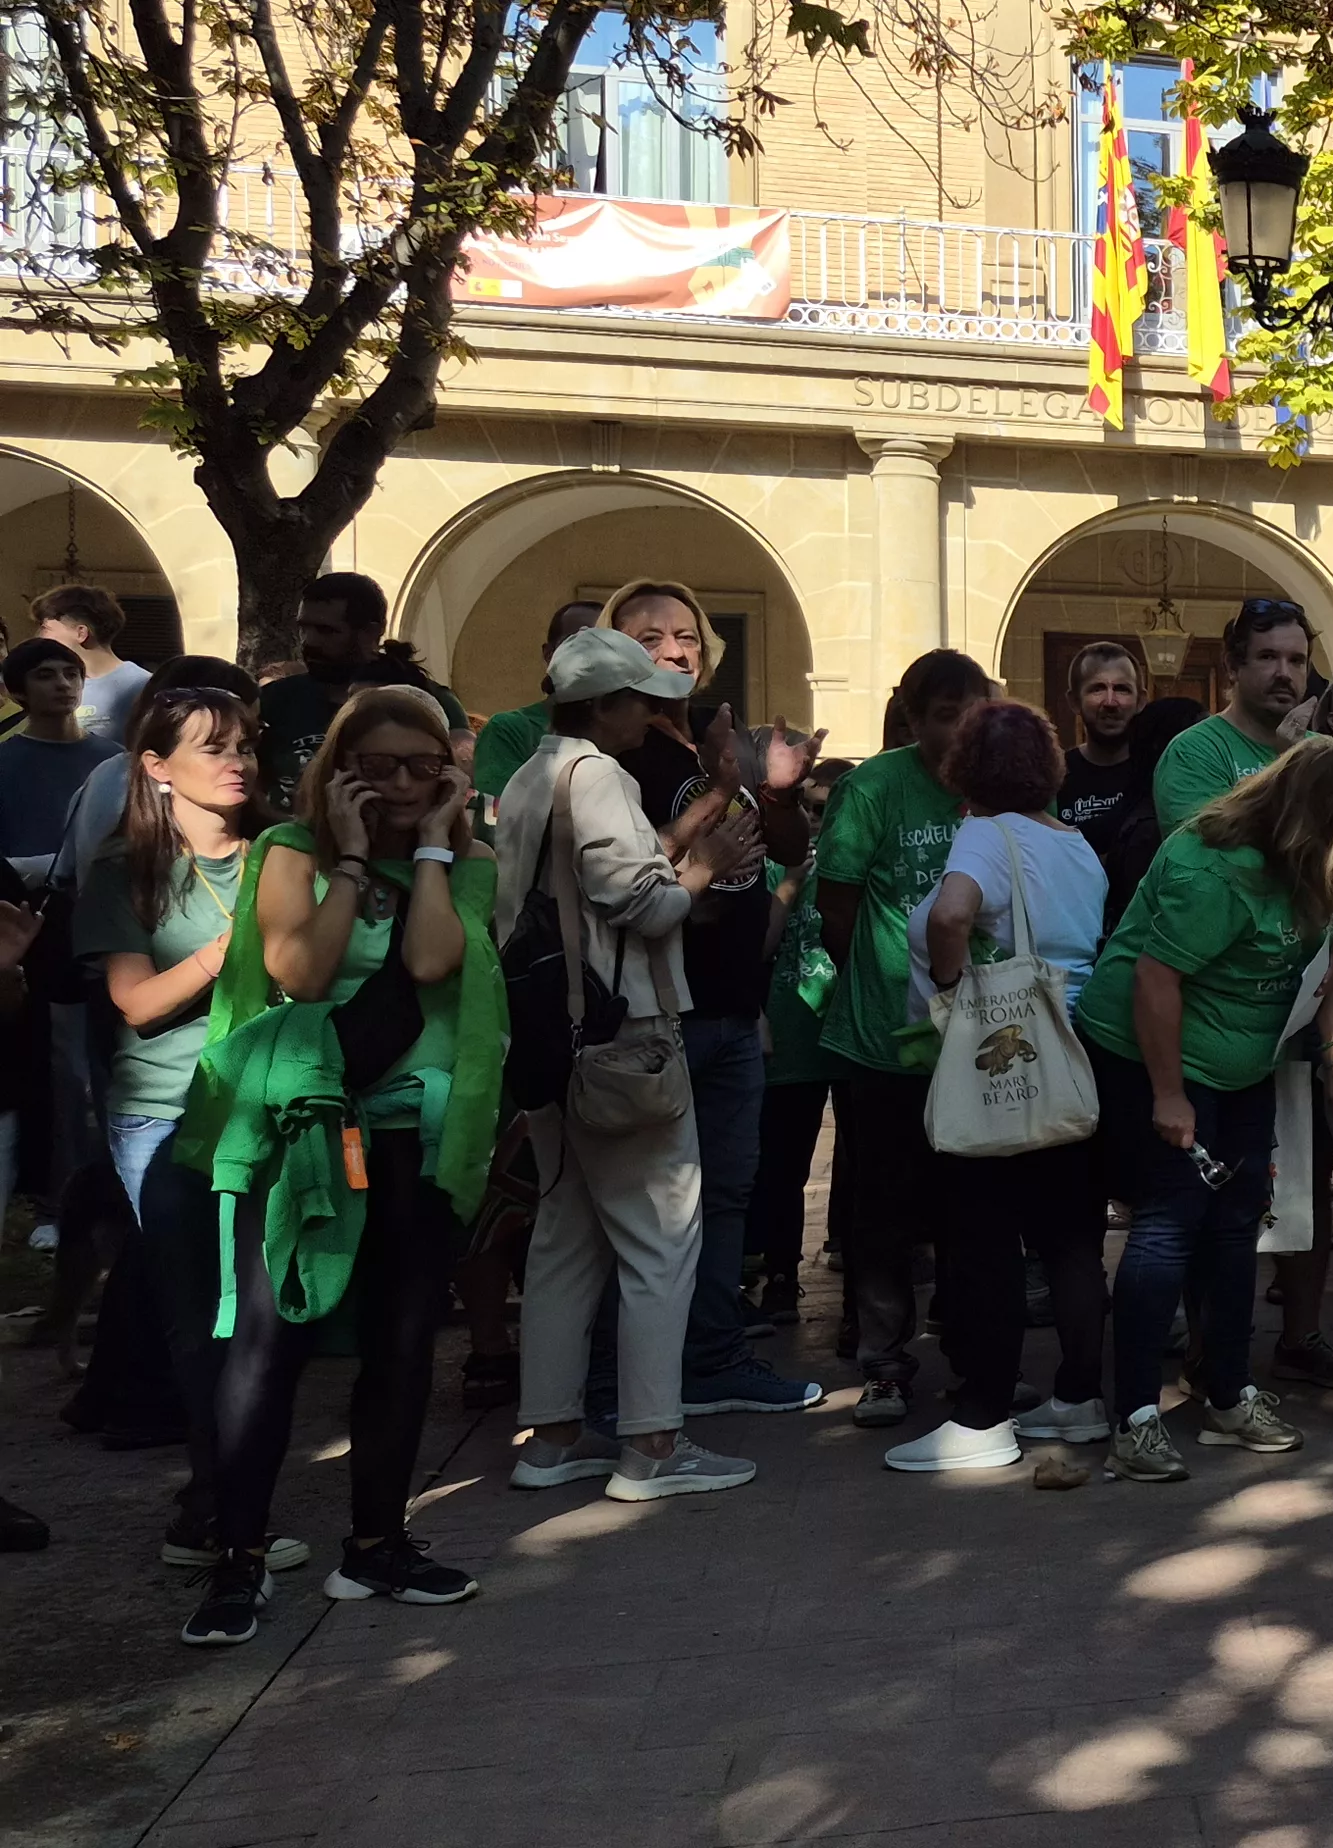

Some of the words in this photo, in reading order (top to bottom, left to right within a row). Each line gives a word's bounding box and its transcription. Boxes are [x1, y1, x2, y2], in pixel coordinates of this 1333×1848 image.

[852, 376, 1202, 430] SUBDELEGAION
[979, 1002, 1036, 1025] ROMA
[989, 1075, 1028, 1091] MARY
[982, 1086, 1039, 1106] BEARD
